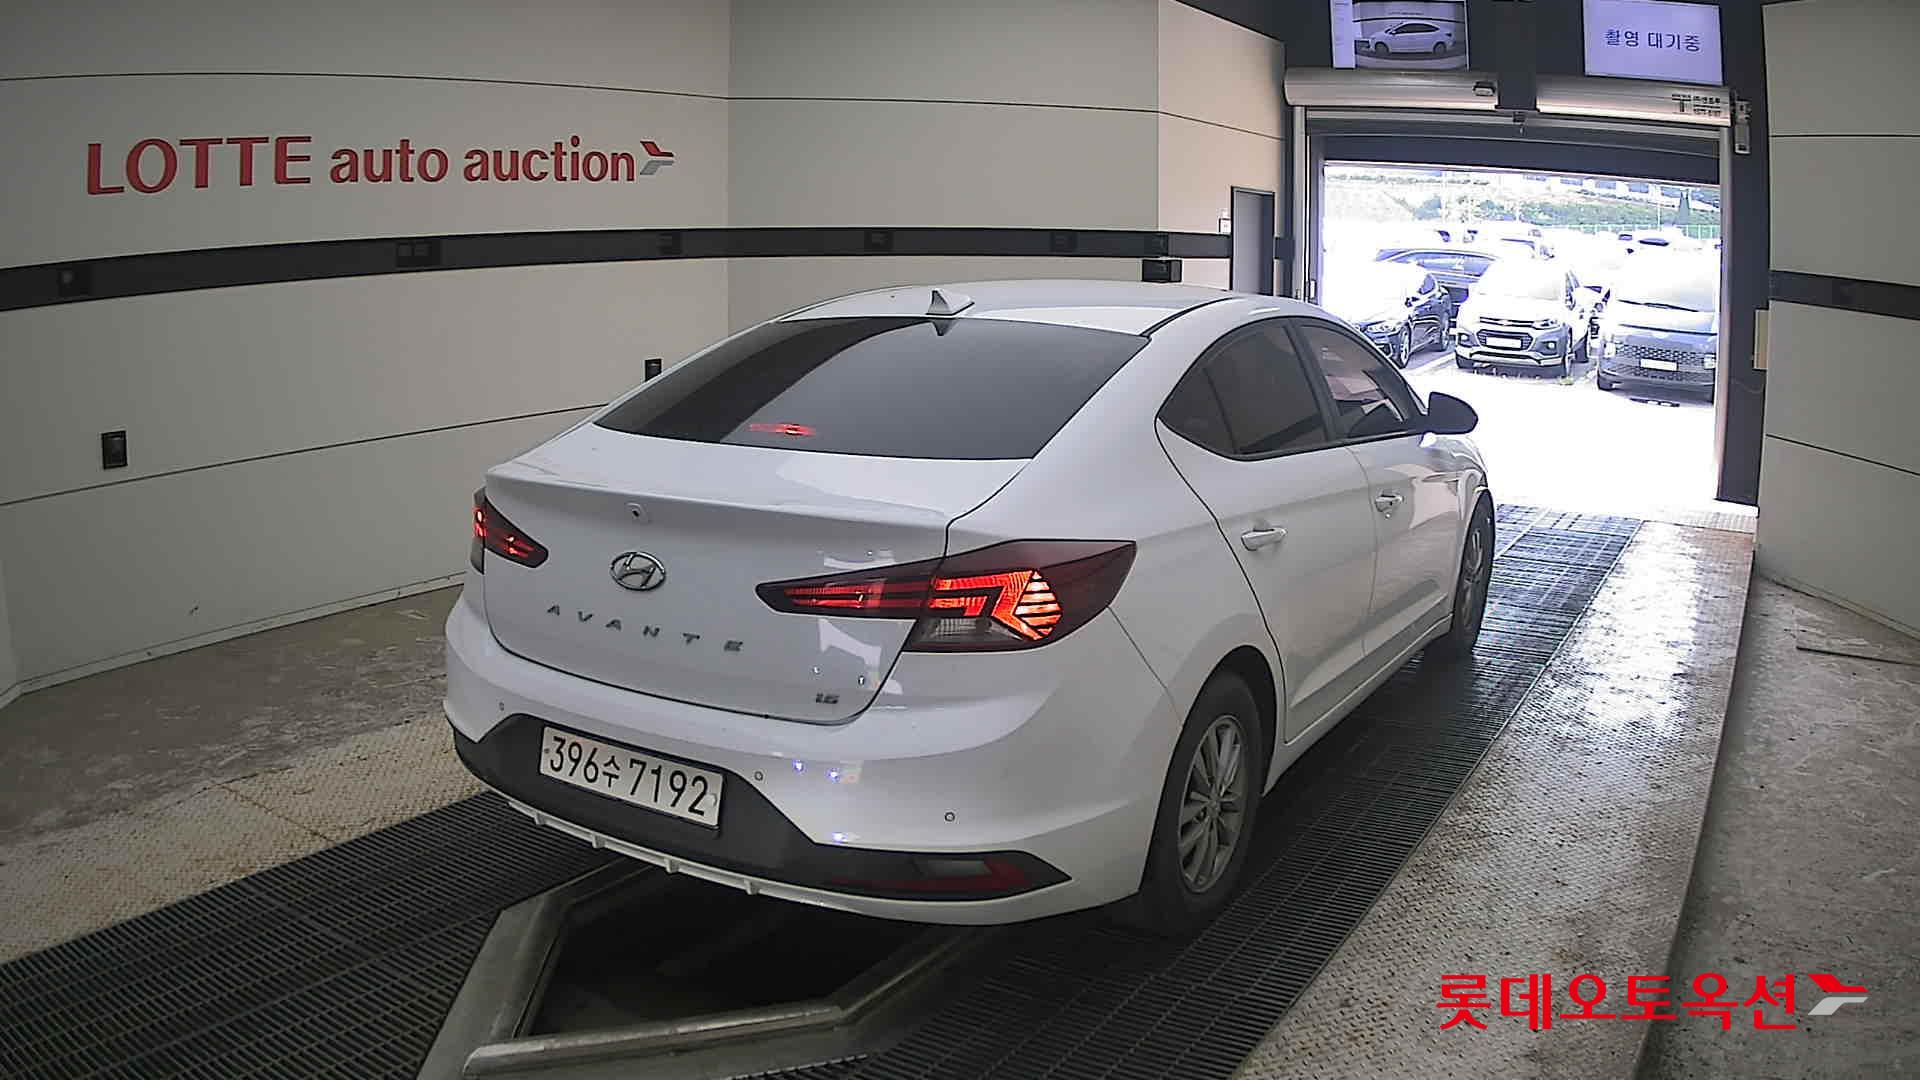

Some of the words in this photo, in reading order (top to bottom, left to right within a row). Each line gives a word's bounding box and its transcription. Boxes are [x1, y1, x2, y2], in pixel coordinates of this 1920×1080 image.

[1648, 32, 1701, 52] 대기중
[87, 136, 312, 195] LOTTE
[329, 139, 450, 183] auto
[463, 135, 636, 183] auction
[547, 604, 744, 652] AVANTE
